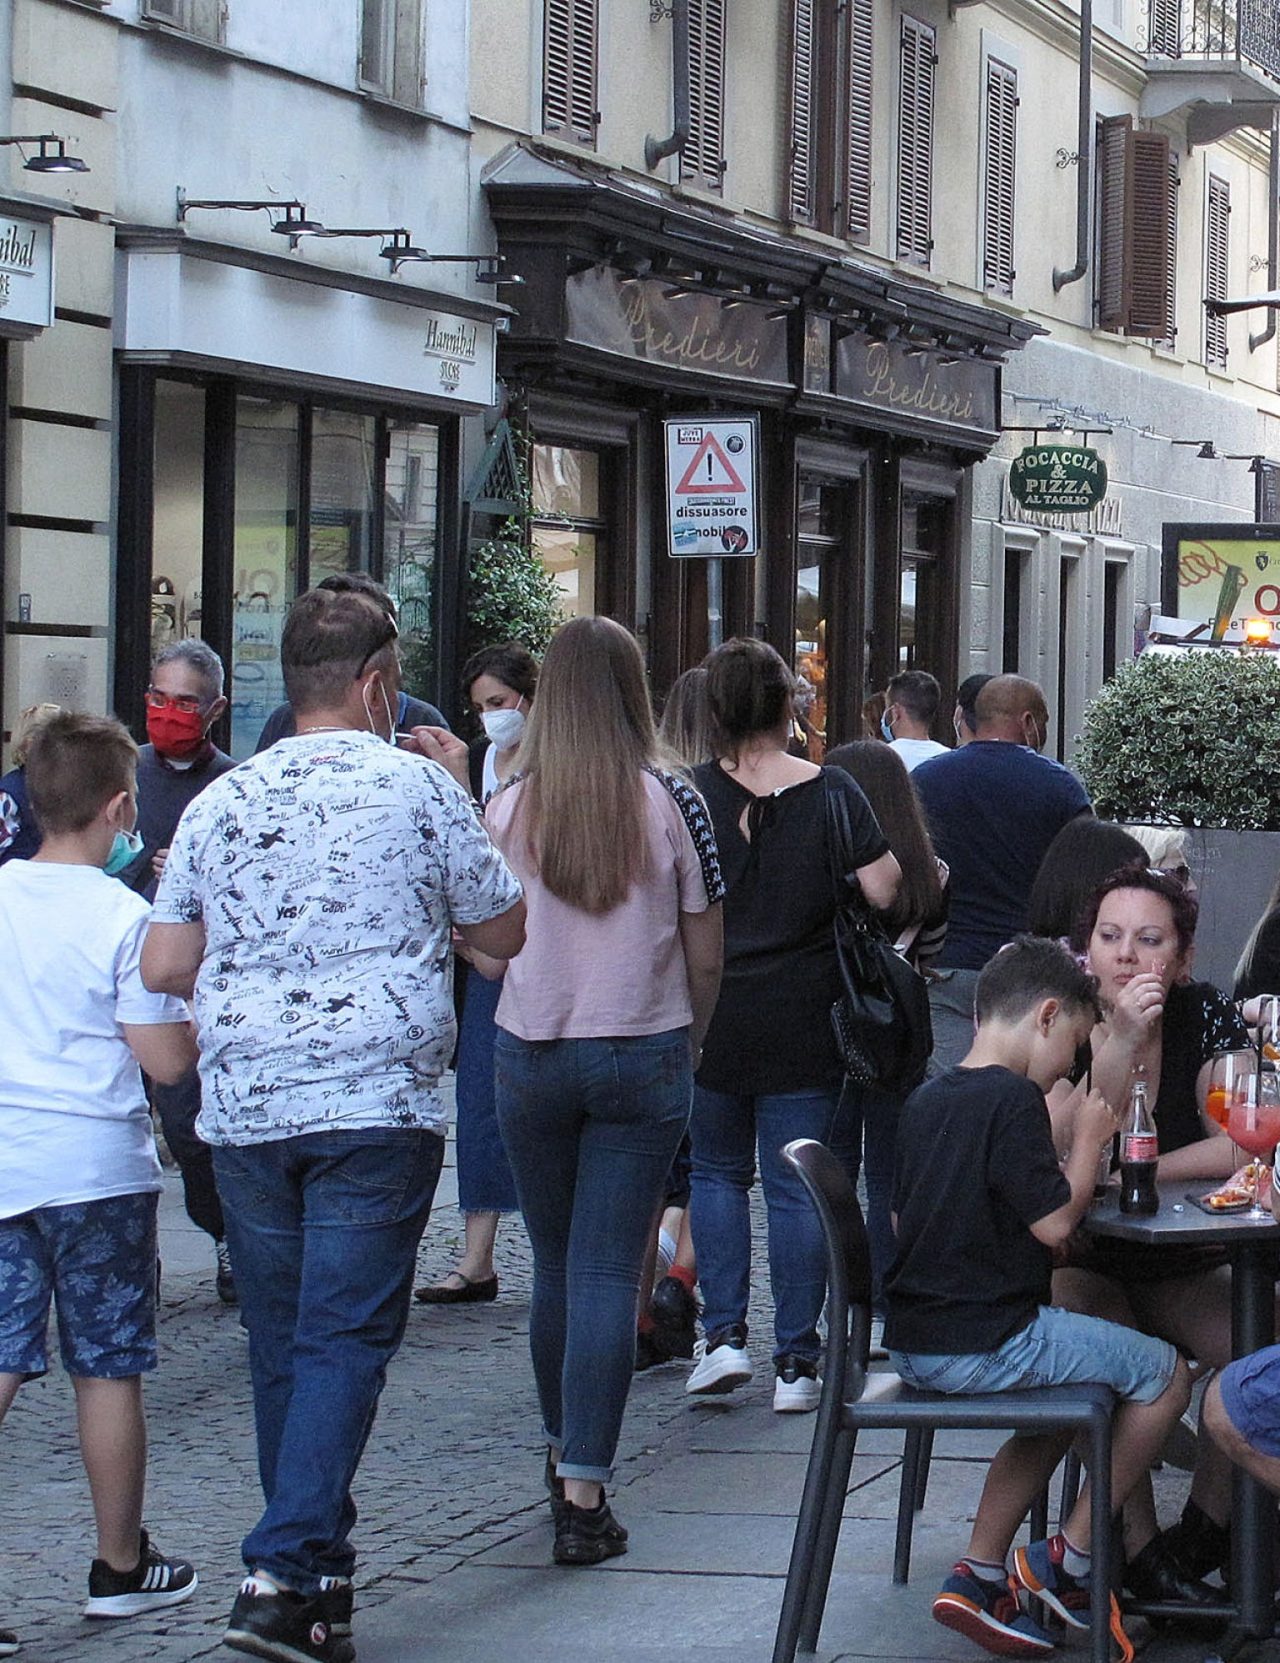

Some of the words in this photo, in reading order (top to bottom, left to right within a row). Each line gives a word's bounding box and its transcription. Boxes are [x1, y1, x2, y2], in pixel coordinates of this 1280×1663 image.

[425, 319, 477, 357] Hannibal
[863, 347, 972, 418] Predieri
[1015, 452, 1098, 474] FOCACCIA
[1050, 465, 1067, 479] &
[1026, 479, 1093, 494] PIZZA
[1025, 495, 1042, 504] AL
[1043, 495, 1089, 505] TAGLIO
[676, 506, 747, 518] dissuasore
